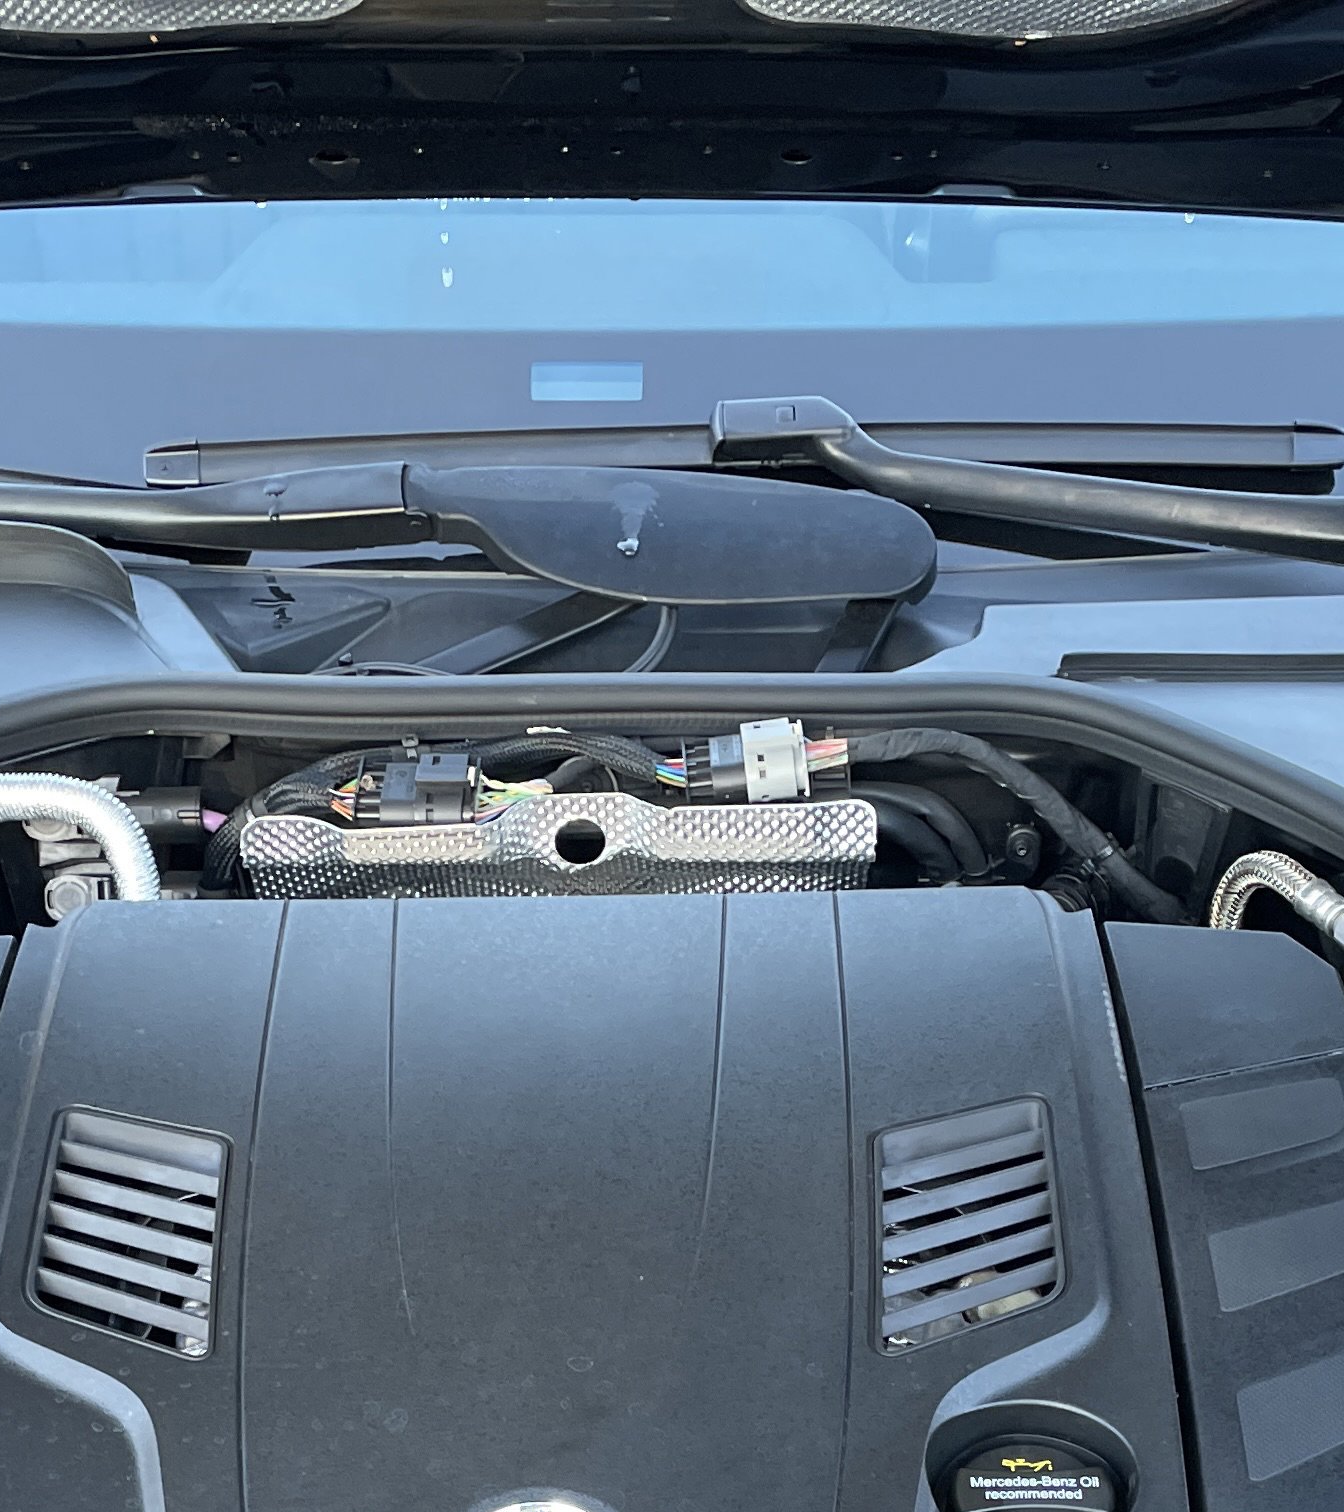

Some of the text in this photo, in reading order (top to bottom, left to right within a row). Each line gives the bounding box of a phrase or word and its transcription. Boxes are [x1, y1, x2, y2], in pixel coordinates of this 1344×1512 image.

[970, 1475, 1100, 1488] Mercedes-Benz Oil
[985, 1489, 1083, 1500] recommended
